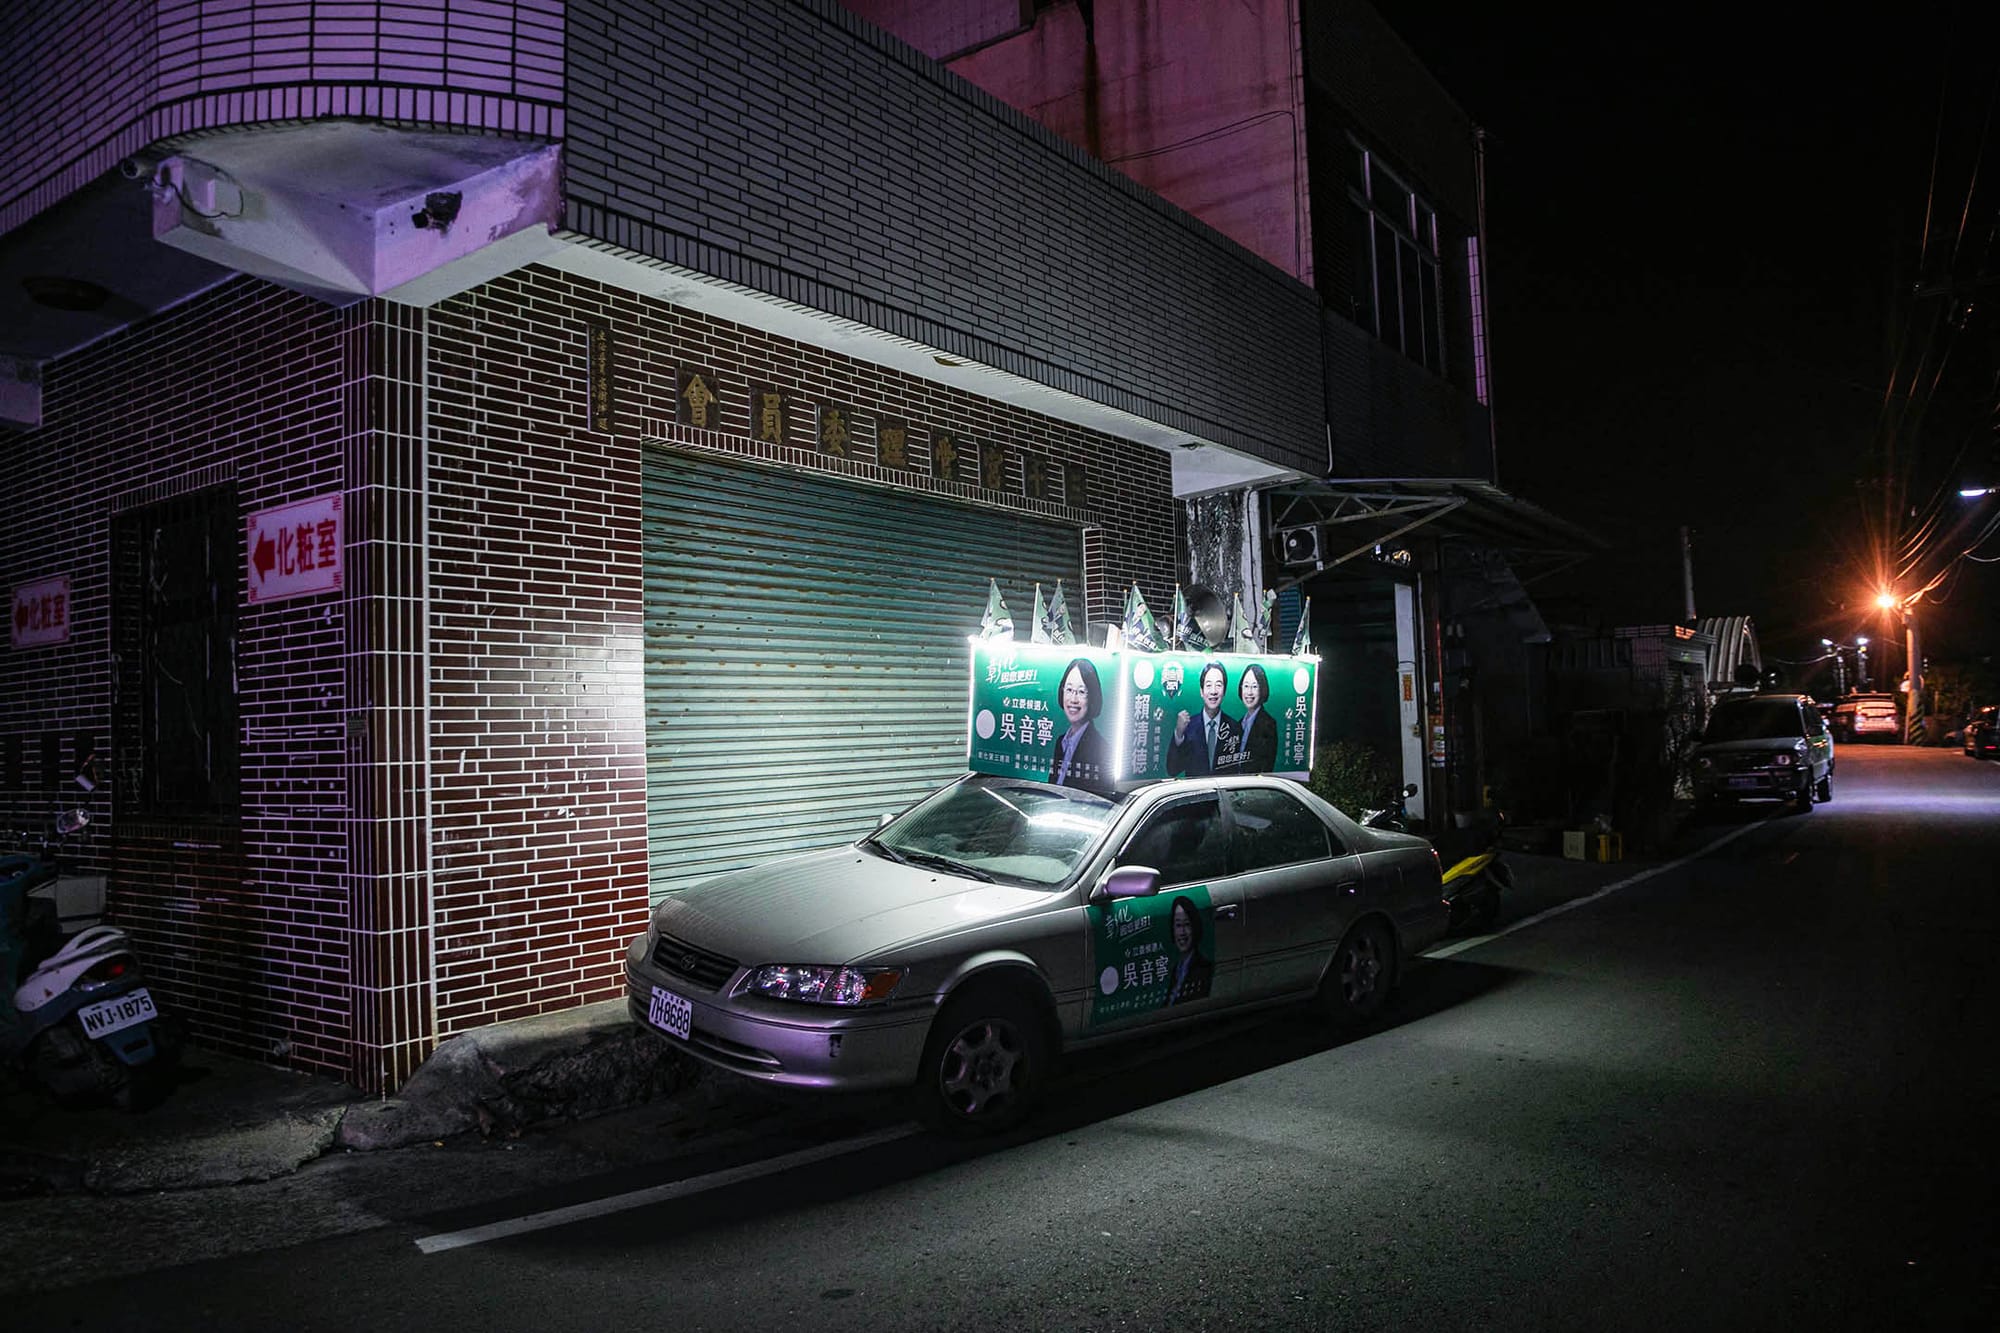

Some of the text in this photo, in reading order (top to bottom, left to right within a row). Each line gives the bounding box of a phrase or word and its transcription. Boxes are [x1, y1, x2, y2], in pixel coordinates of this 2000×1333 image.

[1000, 713, 1054, 746] 吳音寧
[1132, 693, 1151, 774] 賴清德
[1293, 696, 1307, 765] 吳音寧
[1123, 955, 1169, 990] 吳音寧
